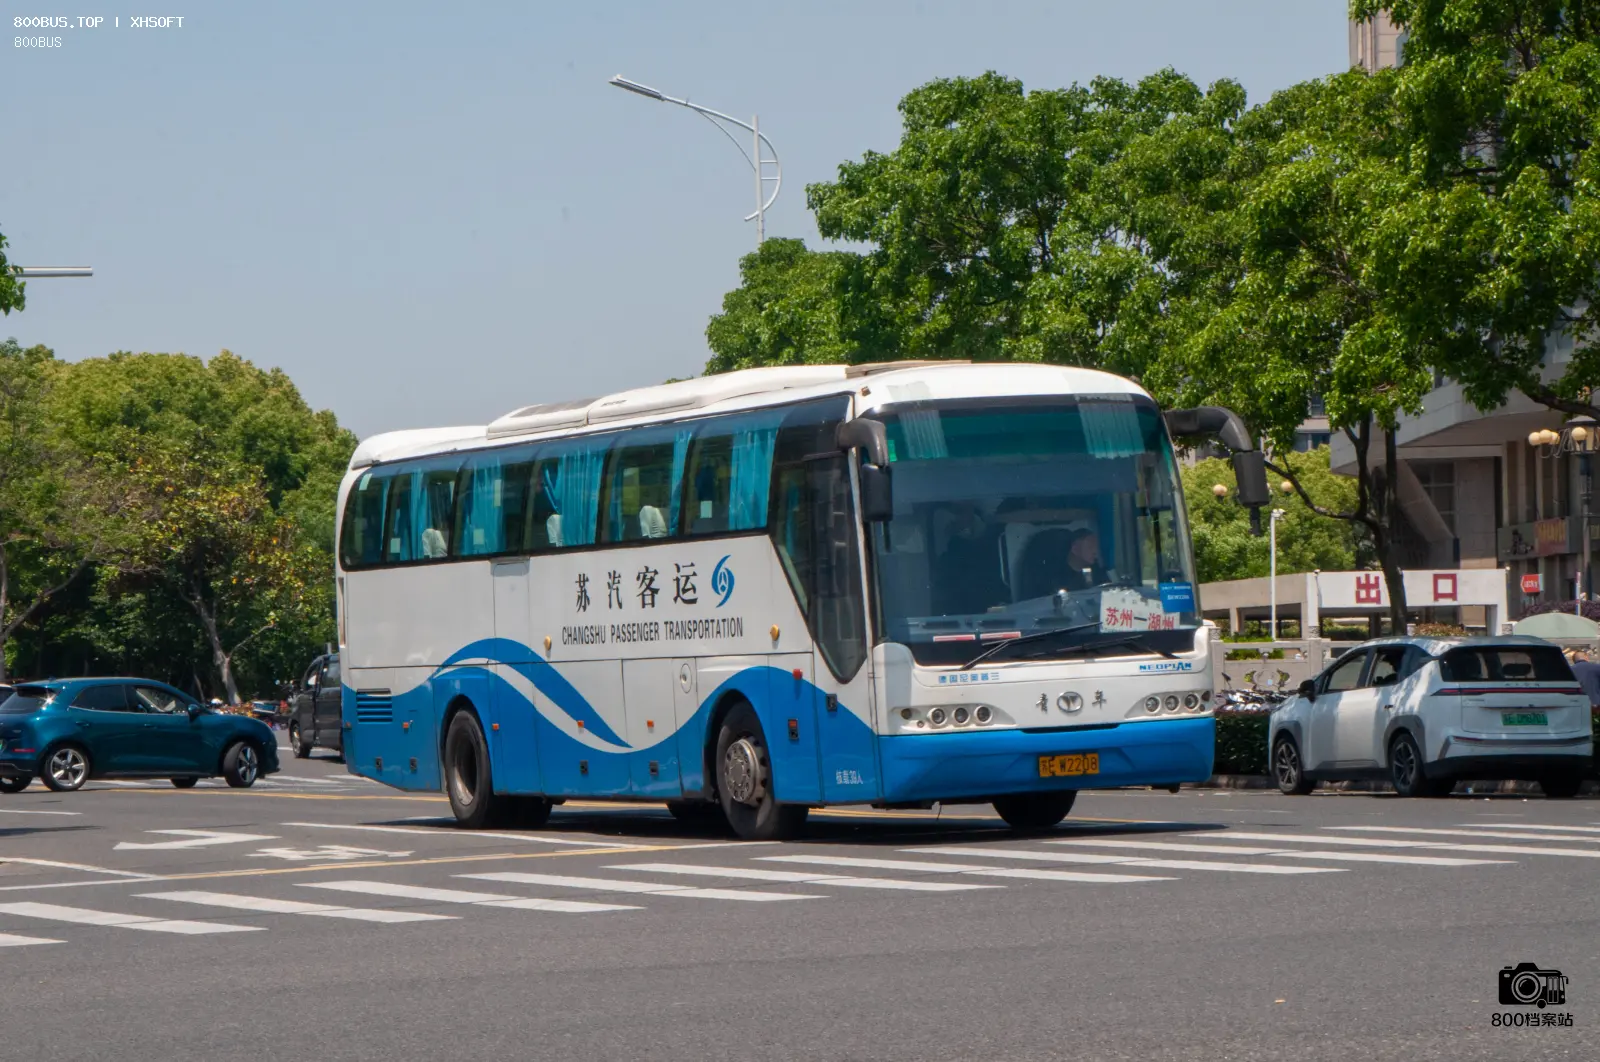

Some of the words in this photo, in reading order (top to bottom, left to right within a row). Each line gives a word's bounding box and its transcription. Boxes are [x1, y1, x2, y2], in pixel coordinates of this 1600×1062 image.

[575, 562, 698, 613] 苏汽客运
[1355, 573, 1458, 605] 出口
[562, 624, 606, 645] CHANGSHU
[610, 621, 660, 644] PASSENGER
[663, 617, 743, 641] TRANSPORTATION
[1139, 662, 1192, 672] NEOPLAN
